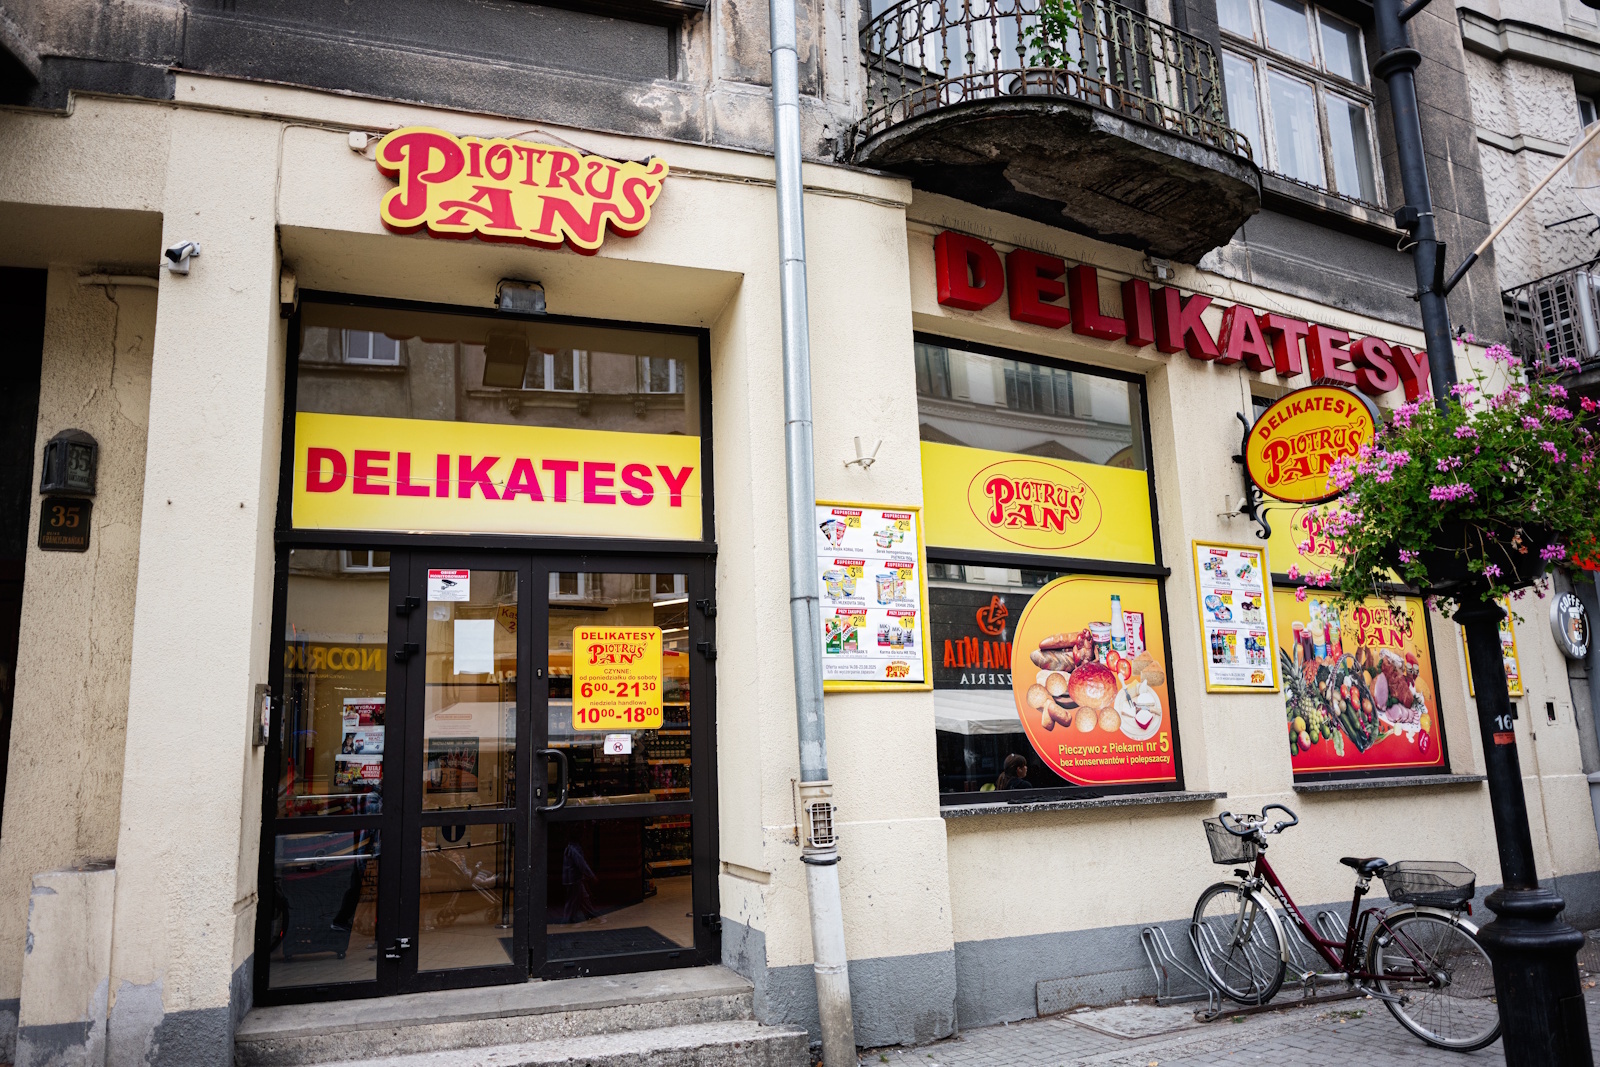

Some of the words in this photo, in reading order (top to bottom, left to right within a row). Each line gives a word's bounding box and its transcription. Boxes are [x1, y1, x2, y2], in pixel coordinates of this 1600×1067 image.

[383, 132, 663, 224] PIOTRUŚ
[935, 230, 1429, 402] DELIKATESY
[1258, 397, 1357, 440] DELIKATESY
[1263, 419, 1364, 485] PIOTRUŚ
[306, 446, 694, 508] DELIKATESY
[986, 478, 1084, 524] PIOTRUŚ
[50, 506, 80, 528] 35
[502, 608, 517, 618] Kas
[1560, 594, 1584, 615] COFFEE
[508, 621, 516, 630] 2
[589, 642, 647, 664] PIOTRUŚ
[1572, 644, 1579, 656] TO
[1579, 644, 1587, 656] GO
[1494, 714, 1512, 730] 16
[1058, 745, 1100, 756] Pieczywo
[1109, 742, 1144, 753] Piekarni
[1146, 742, 1157, 752] nr
[1160, 732, 1169, 752] 5
[1075, 756, 1125, 766] konserwantów
[1130, 755, 1170, 765] polepszaczy
